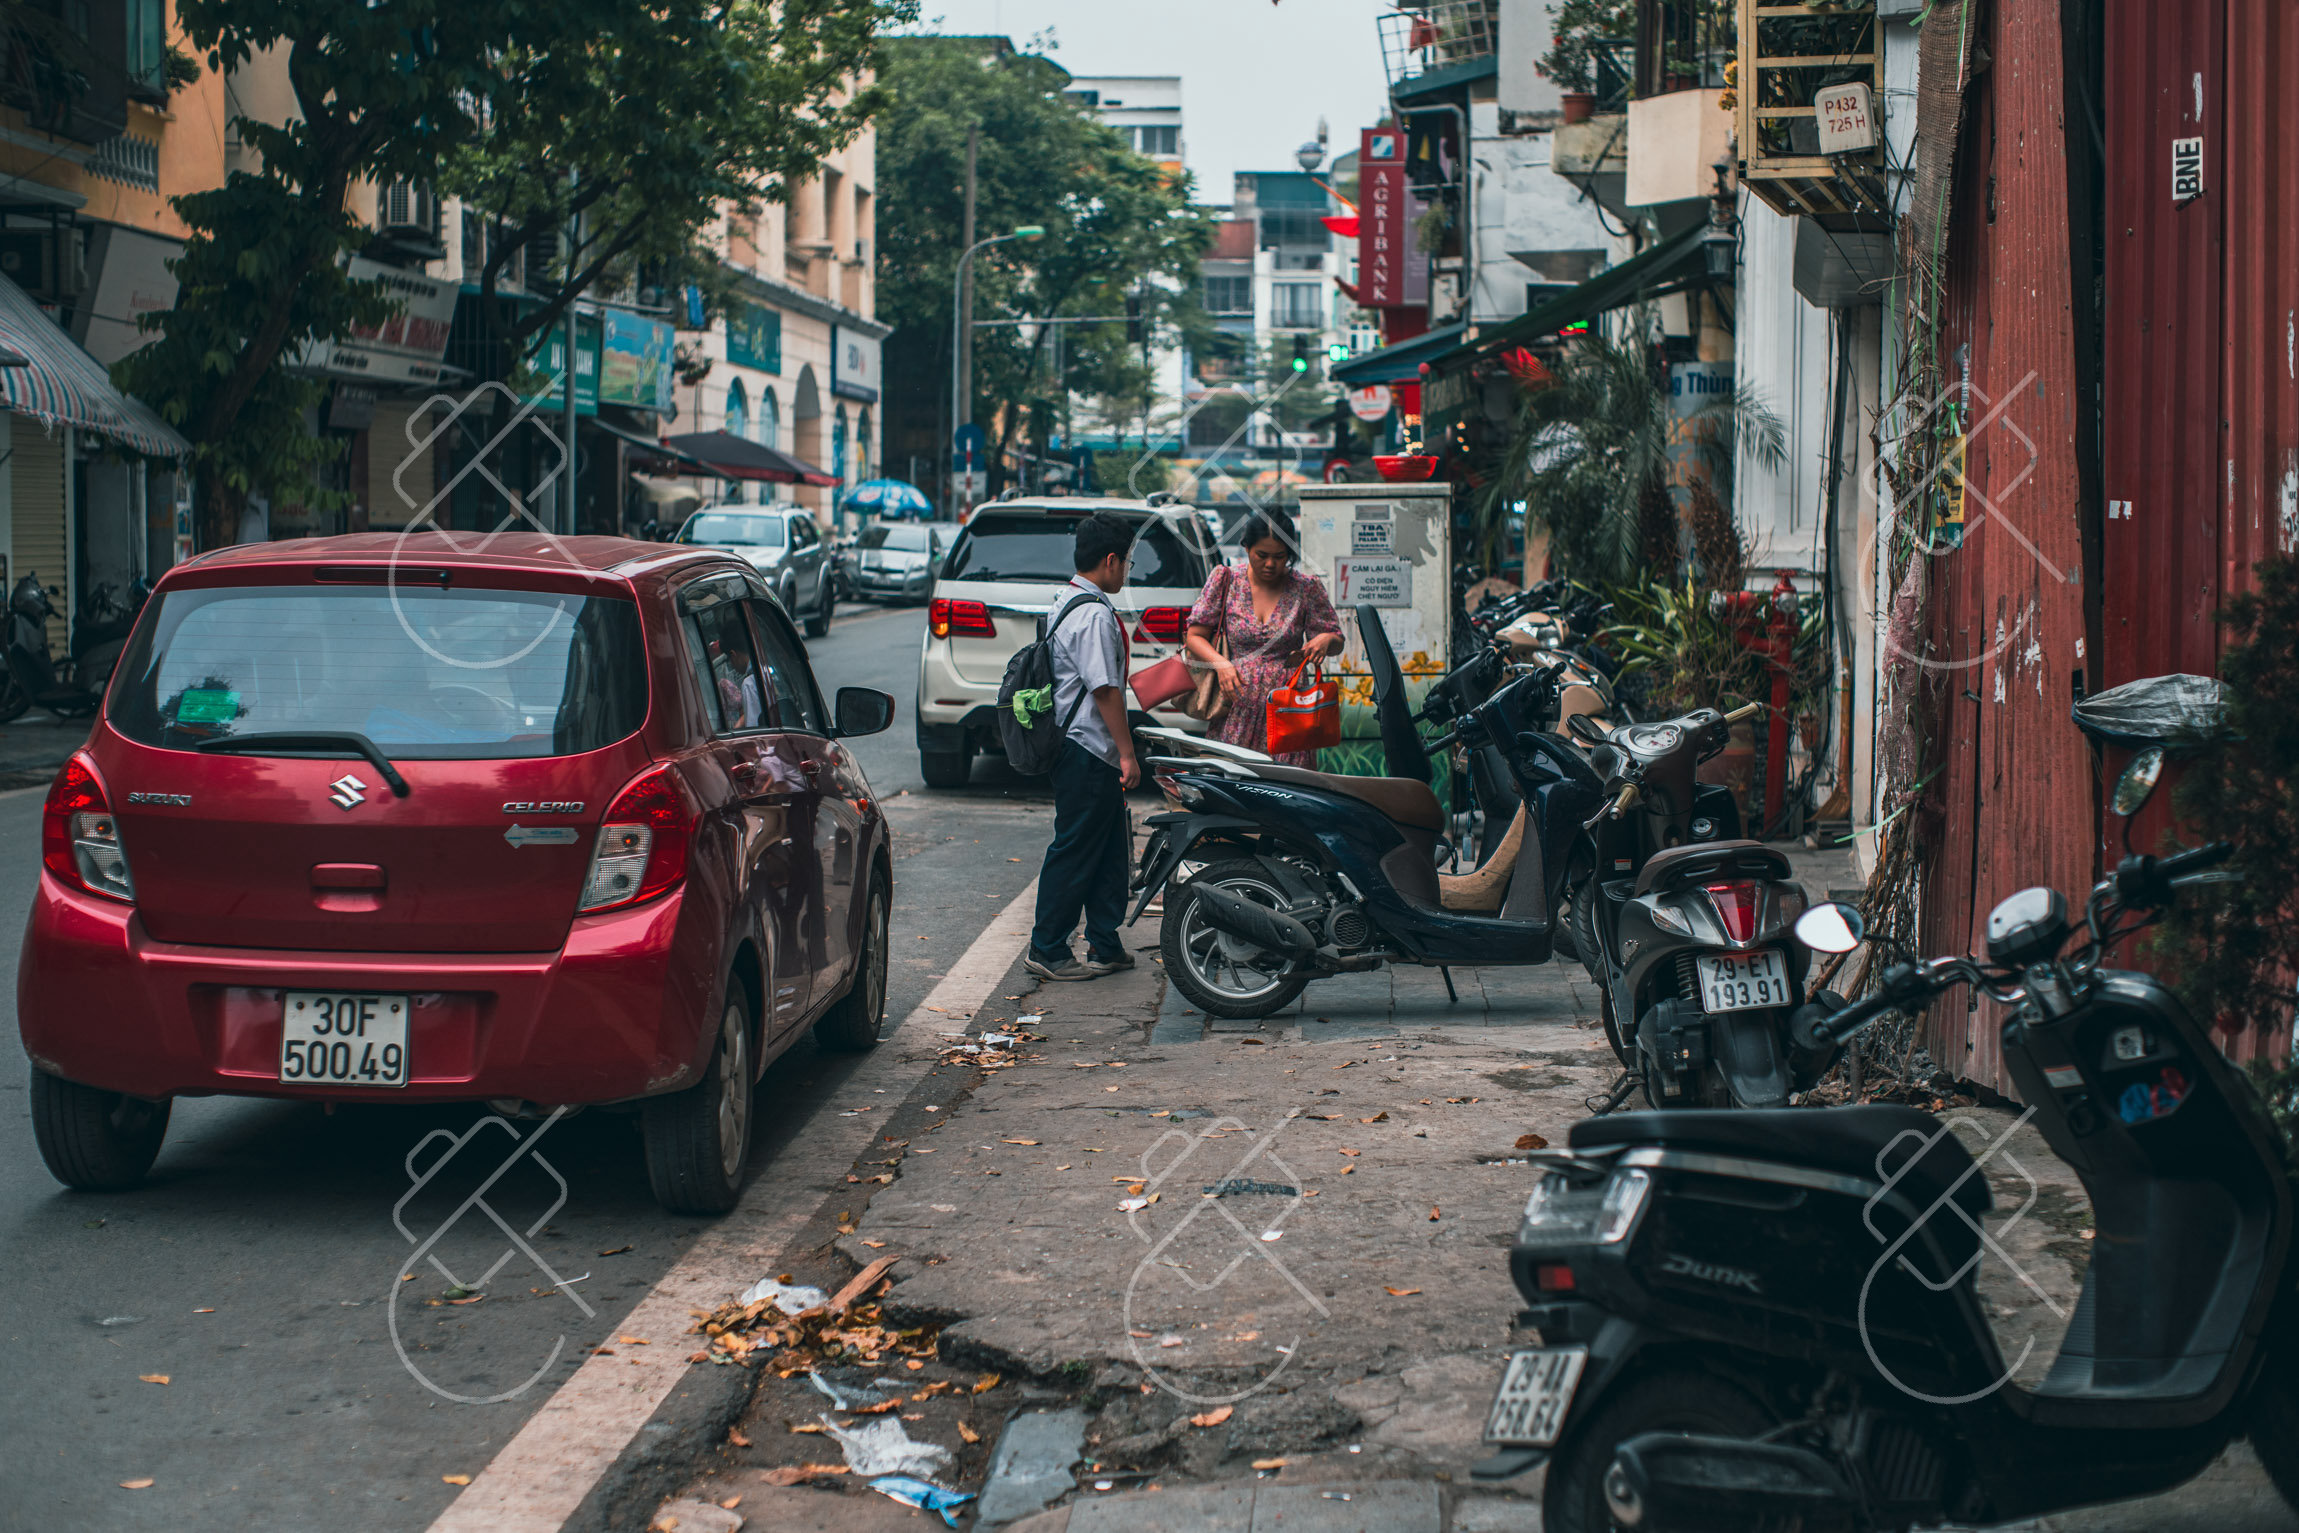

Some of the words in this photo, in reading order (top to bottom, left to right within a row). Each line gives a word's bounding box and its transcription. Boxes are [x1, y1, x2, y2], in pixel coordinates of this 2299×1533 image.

[1855, 113, 1866, 128] H
[2175, 141, 2200, 195] BNE
[1373, 170, 1390, 302] AGRIBANK
[128, 791, 193, 807] SUZUKI
[1235, 783, 1294, 799] VISION
[502, 801, 585, 814] CELERIO
[1710, 953, 1773, 982] 29-E1
[1710, 978, 1784, 1009] 193.91
[312, 997, 380, 1037] 30F
[283, 1040, 402, 1082] 500.49
